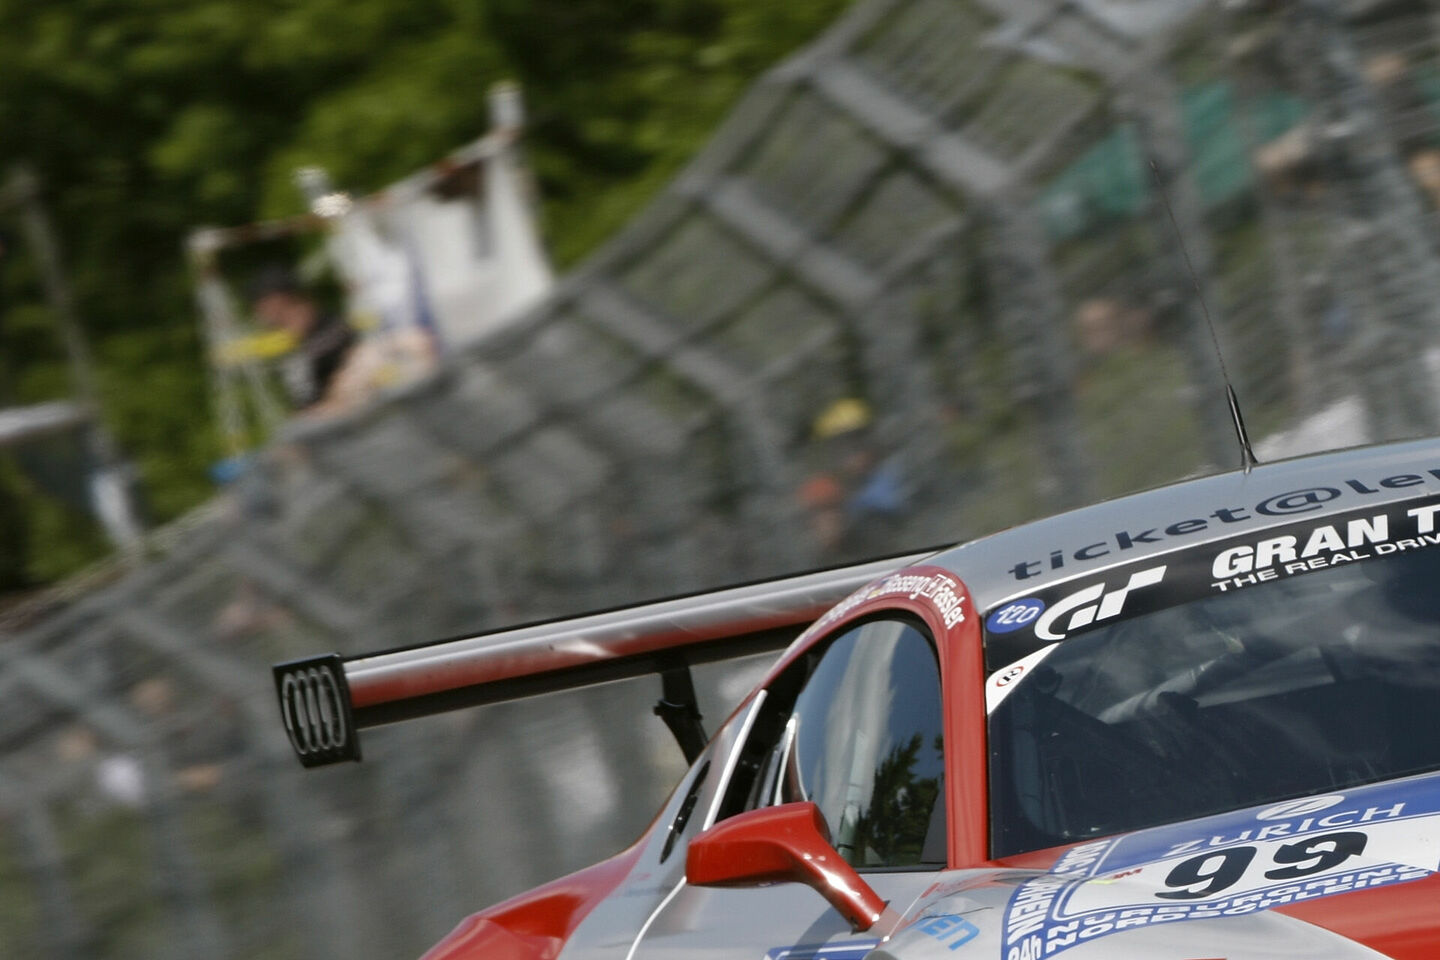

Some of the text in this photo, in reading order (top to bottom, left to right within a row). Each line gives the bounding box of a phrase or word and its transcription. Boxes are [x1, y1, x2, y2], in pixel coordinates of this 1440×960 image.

[1211, 514, 1389, 580] GRAN
[1211, 567, 1279, 592] THE
[1286, 549, 1371, 575] REAL
[996, 605, 1040, 625] 120
[1161, 802, 1406, 858] ZURICH
[1154, 831, 1368, 900] 99
